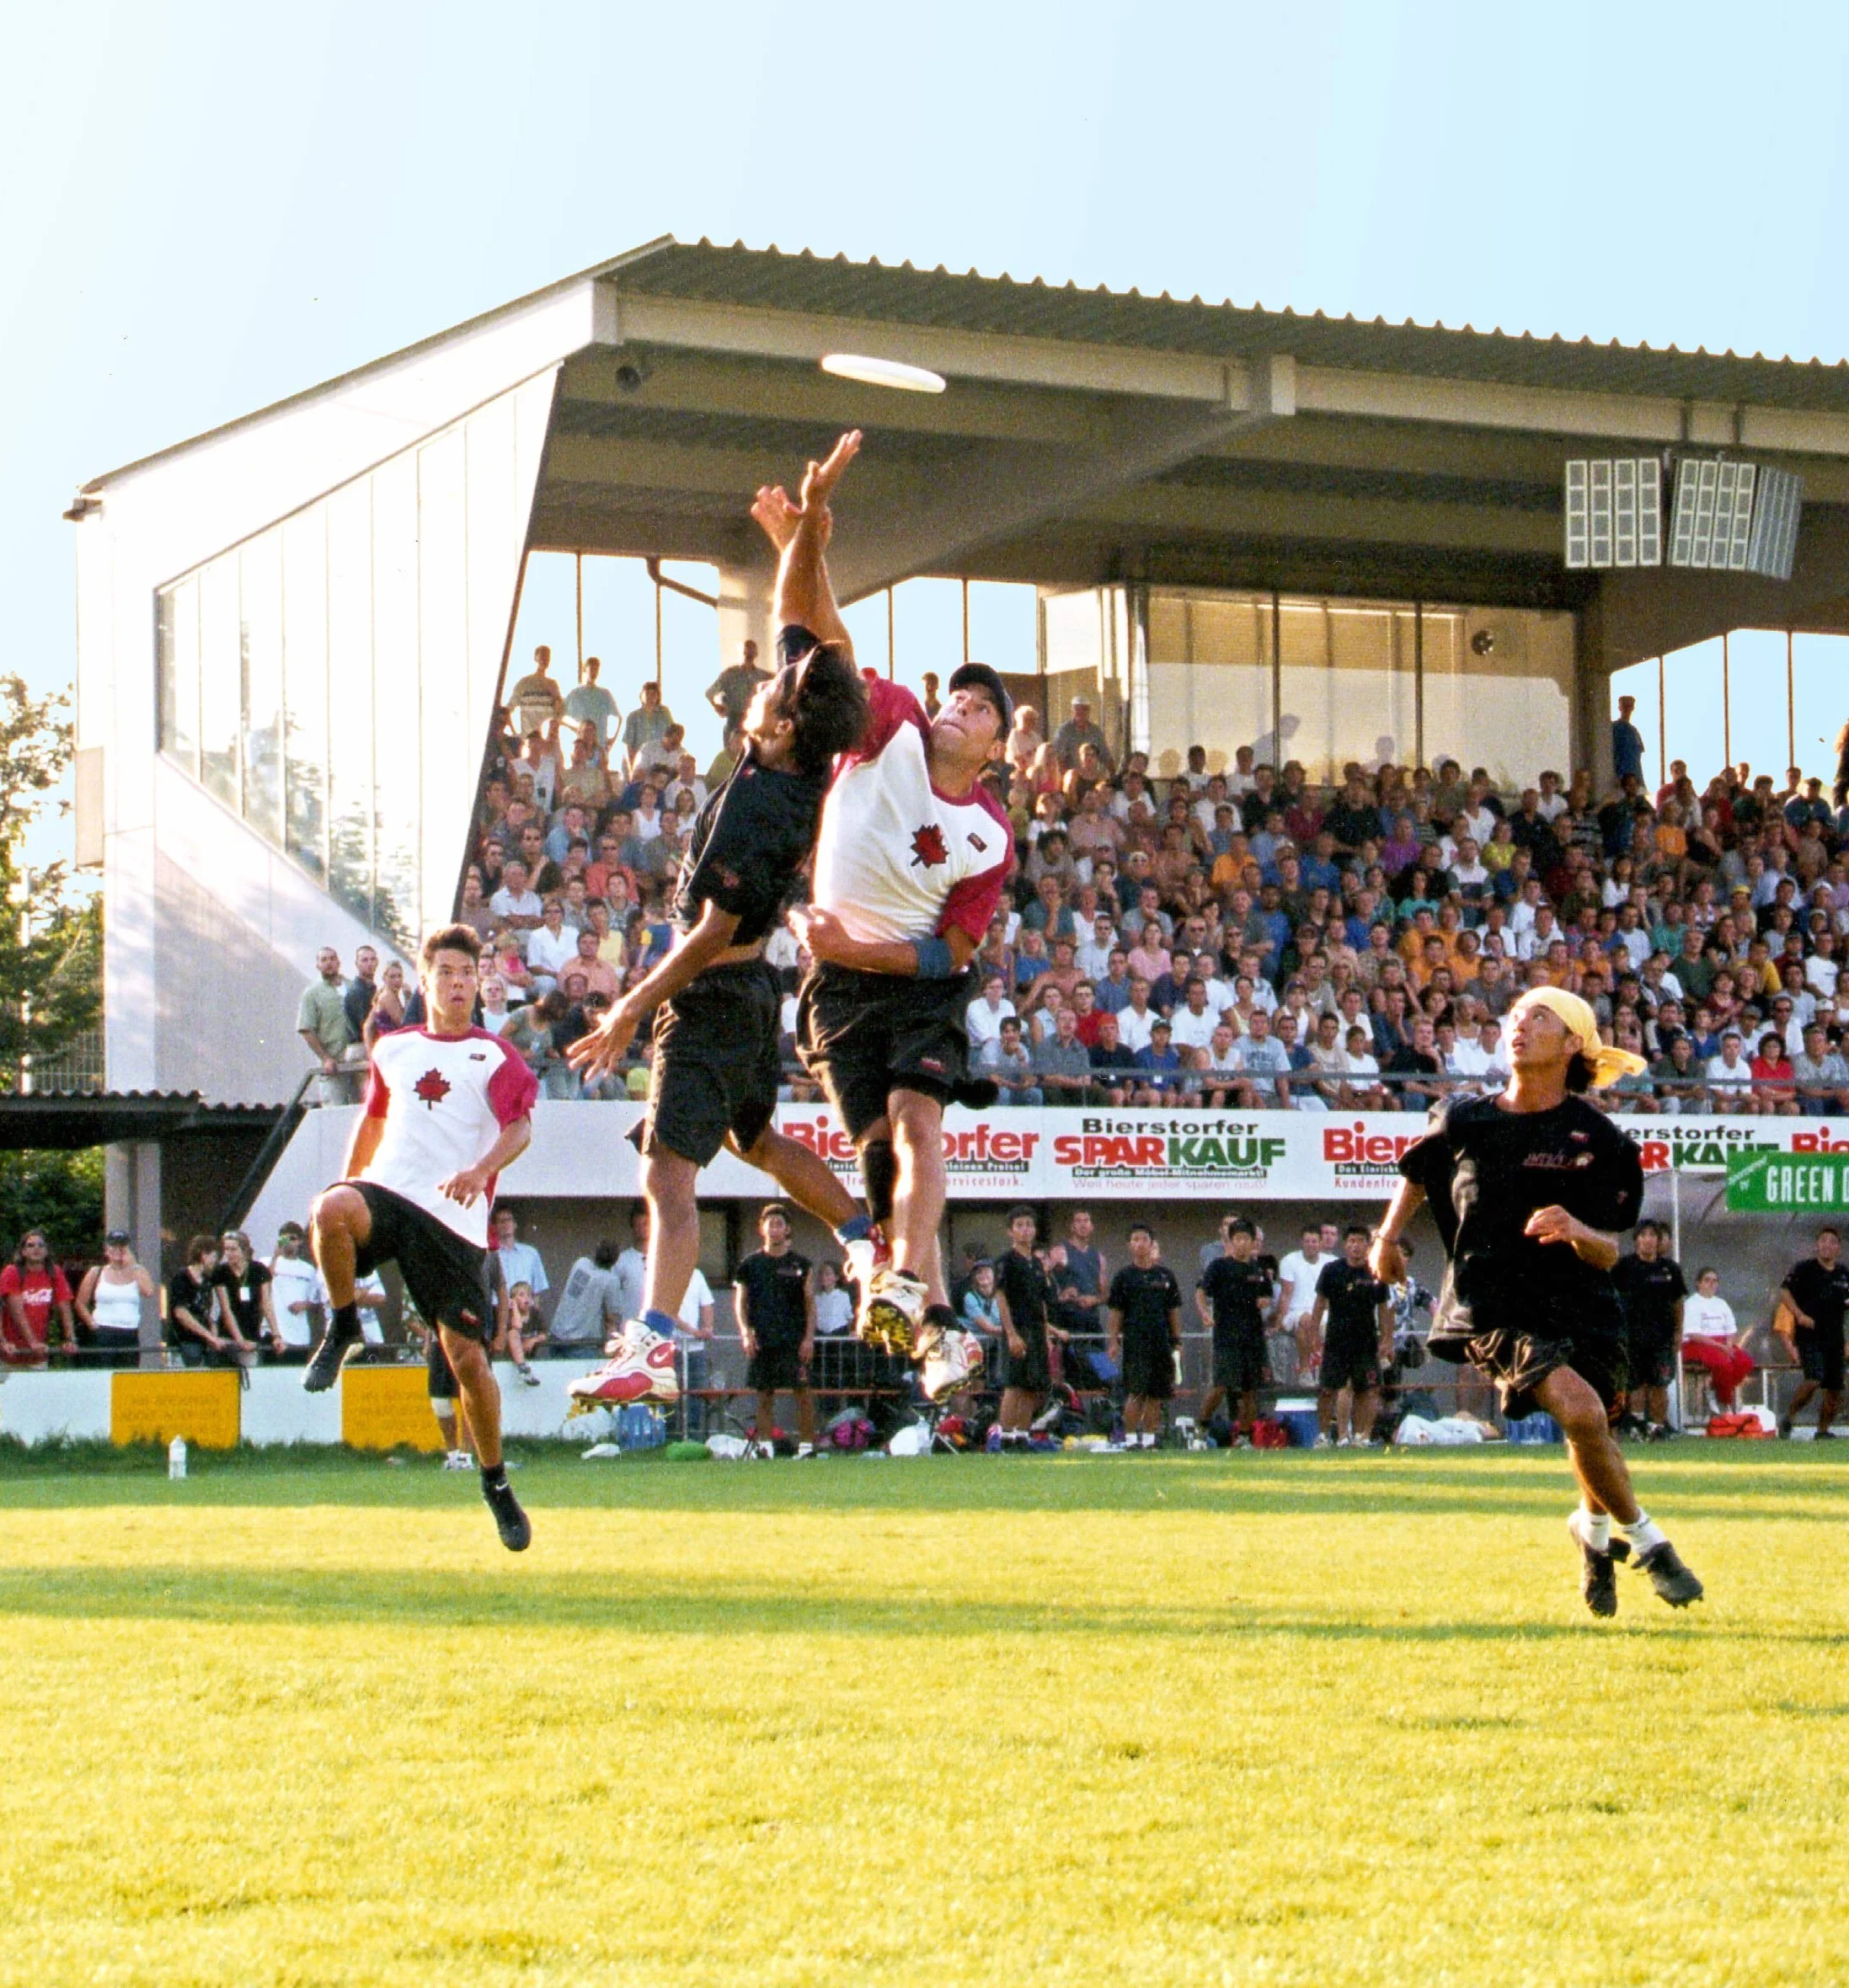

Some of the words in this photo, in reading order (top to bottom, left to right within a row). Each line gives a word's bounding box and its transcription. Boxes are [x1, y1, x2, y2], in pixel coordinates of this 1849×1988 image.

[1082, 1118, 1259, 1135] Bierstorfer
[1626, 1125, 1755, 1141] erstorfer
[1053, 1136, 1286, 1168] SPARKAUF
[1767, 1165, 1835, 1203] GREEN
